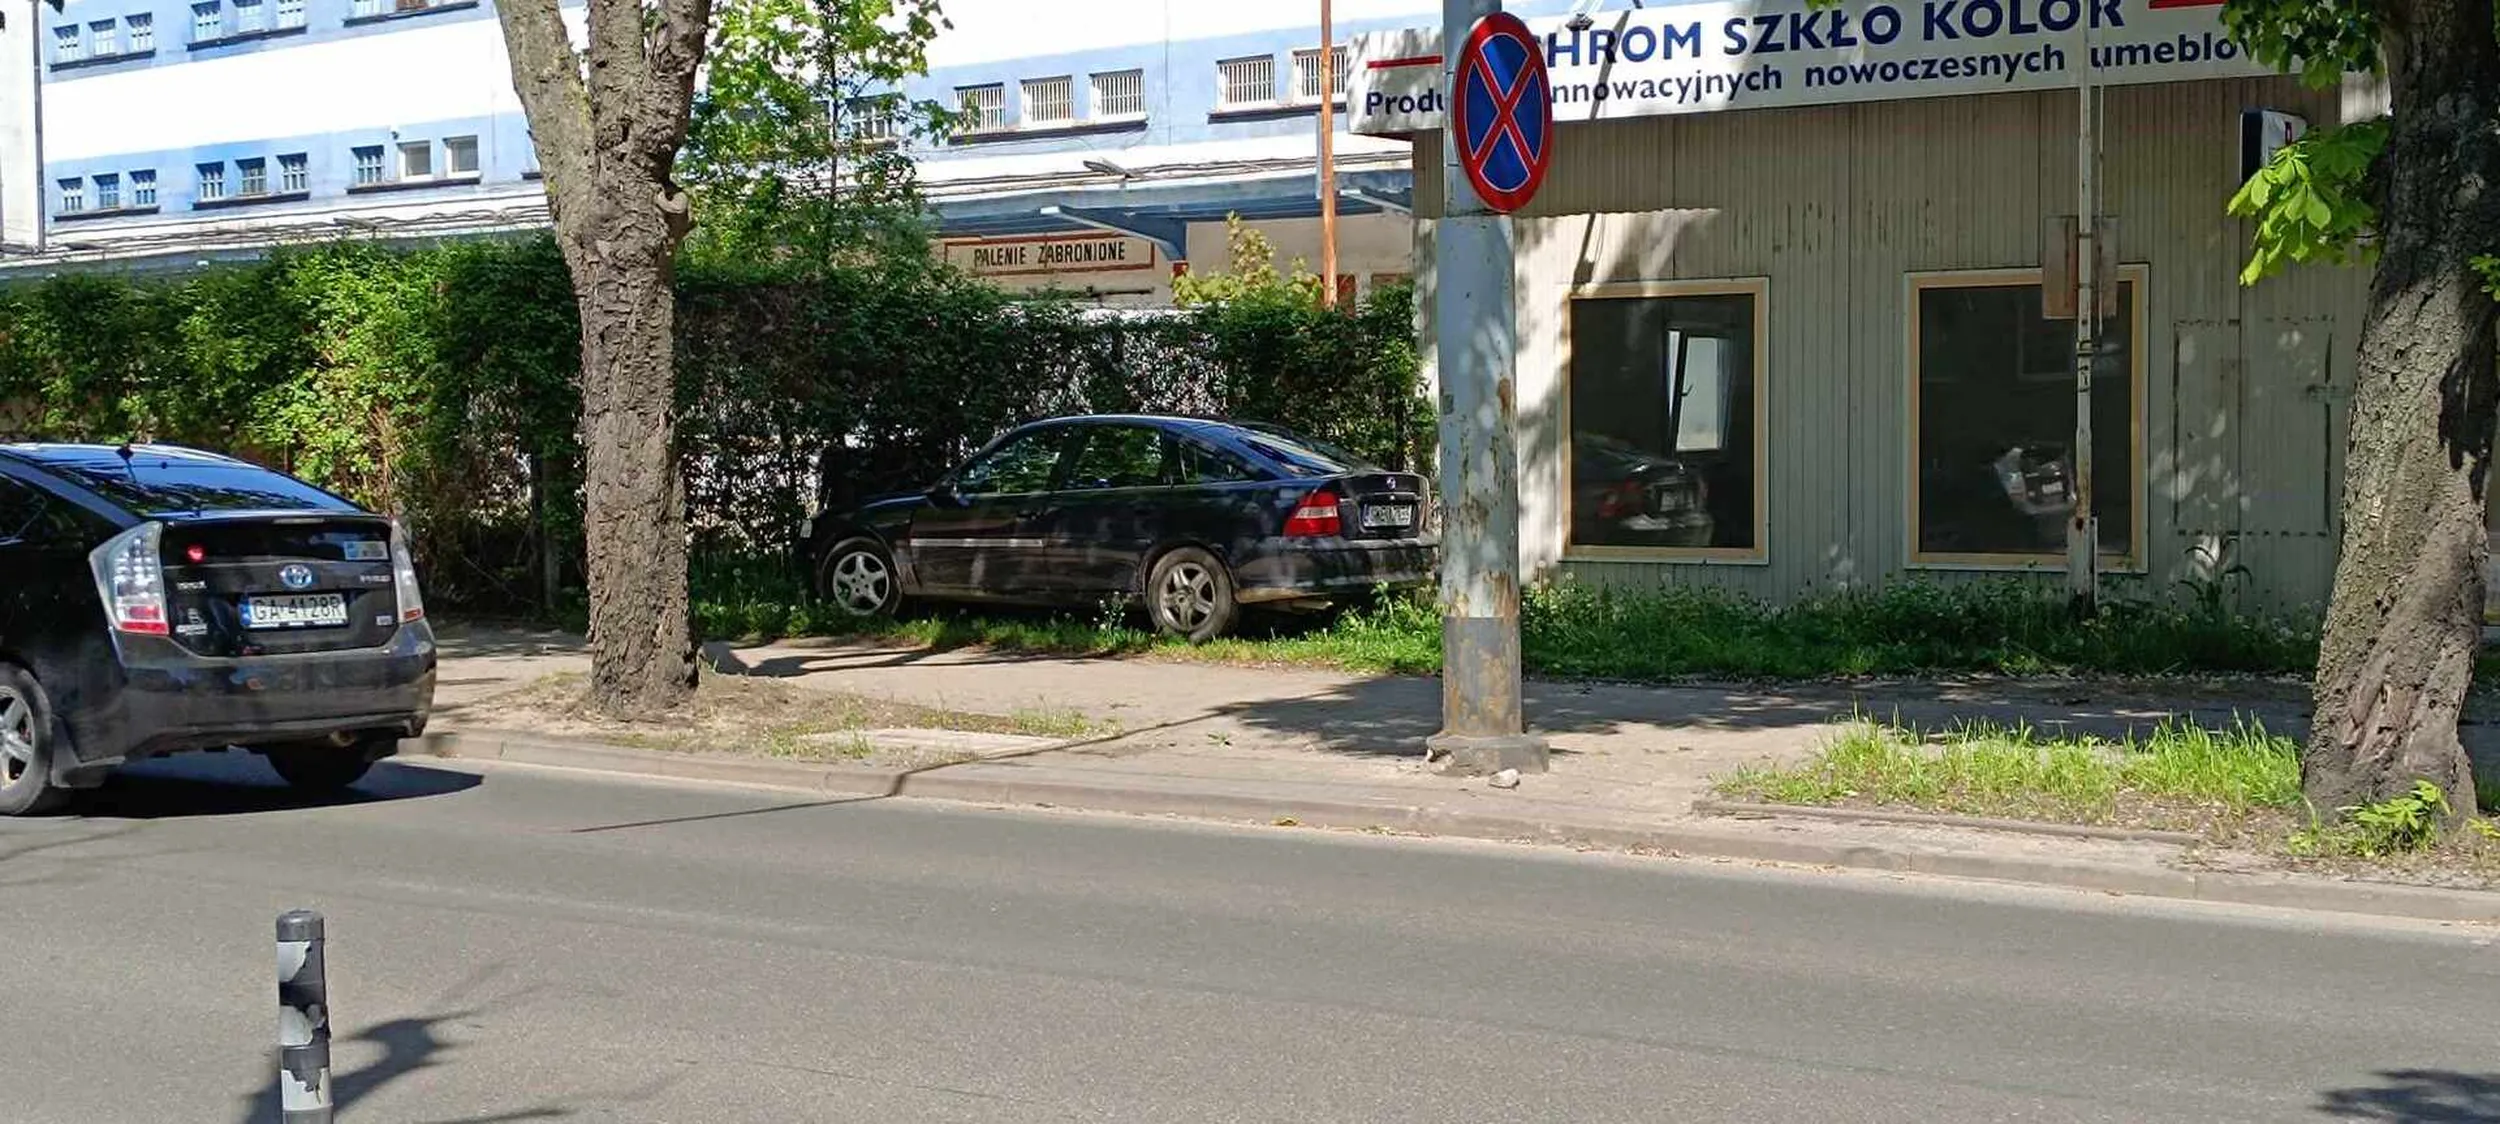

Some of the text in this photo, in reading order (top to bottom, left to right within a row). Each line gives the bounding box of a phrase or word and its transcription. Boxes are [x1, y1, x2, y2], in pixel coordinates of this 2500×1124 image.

[1532, 0, 2125, 68] HROM SZKŁO KOLOR
[1551, 64, 1782, 104] nnowacyjnych
[1805, 43, 2066, 87] nowoczesnych
[974, 242, 1126, 268] PALENIE ZABRONIONE
